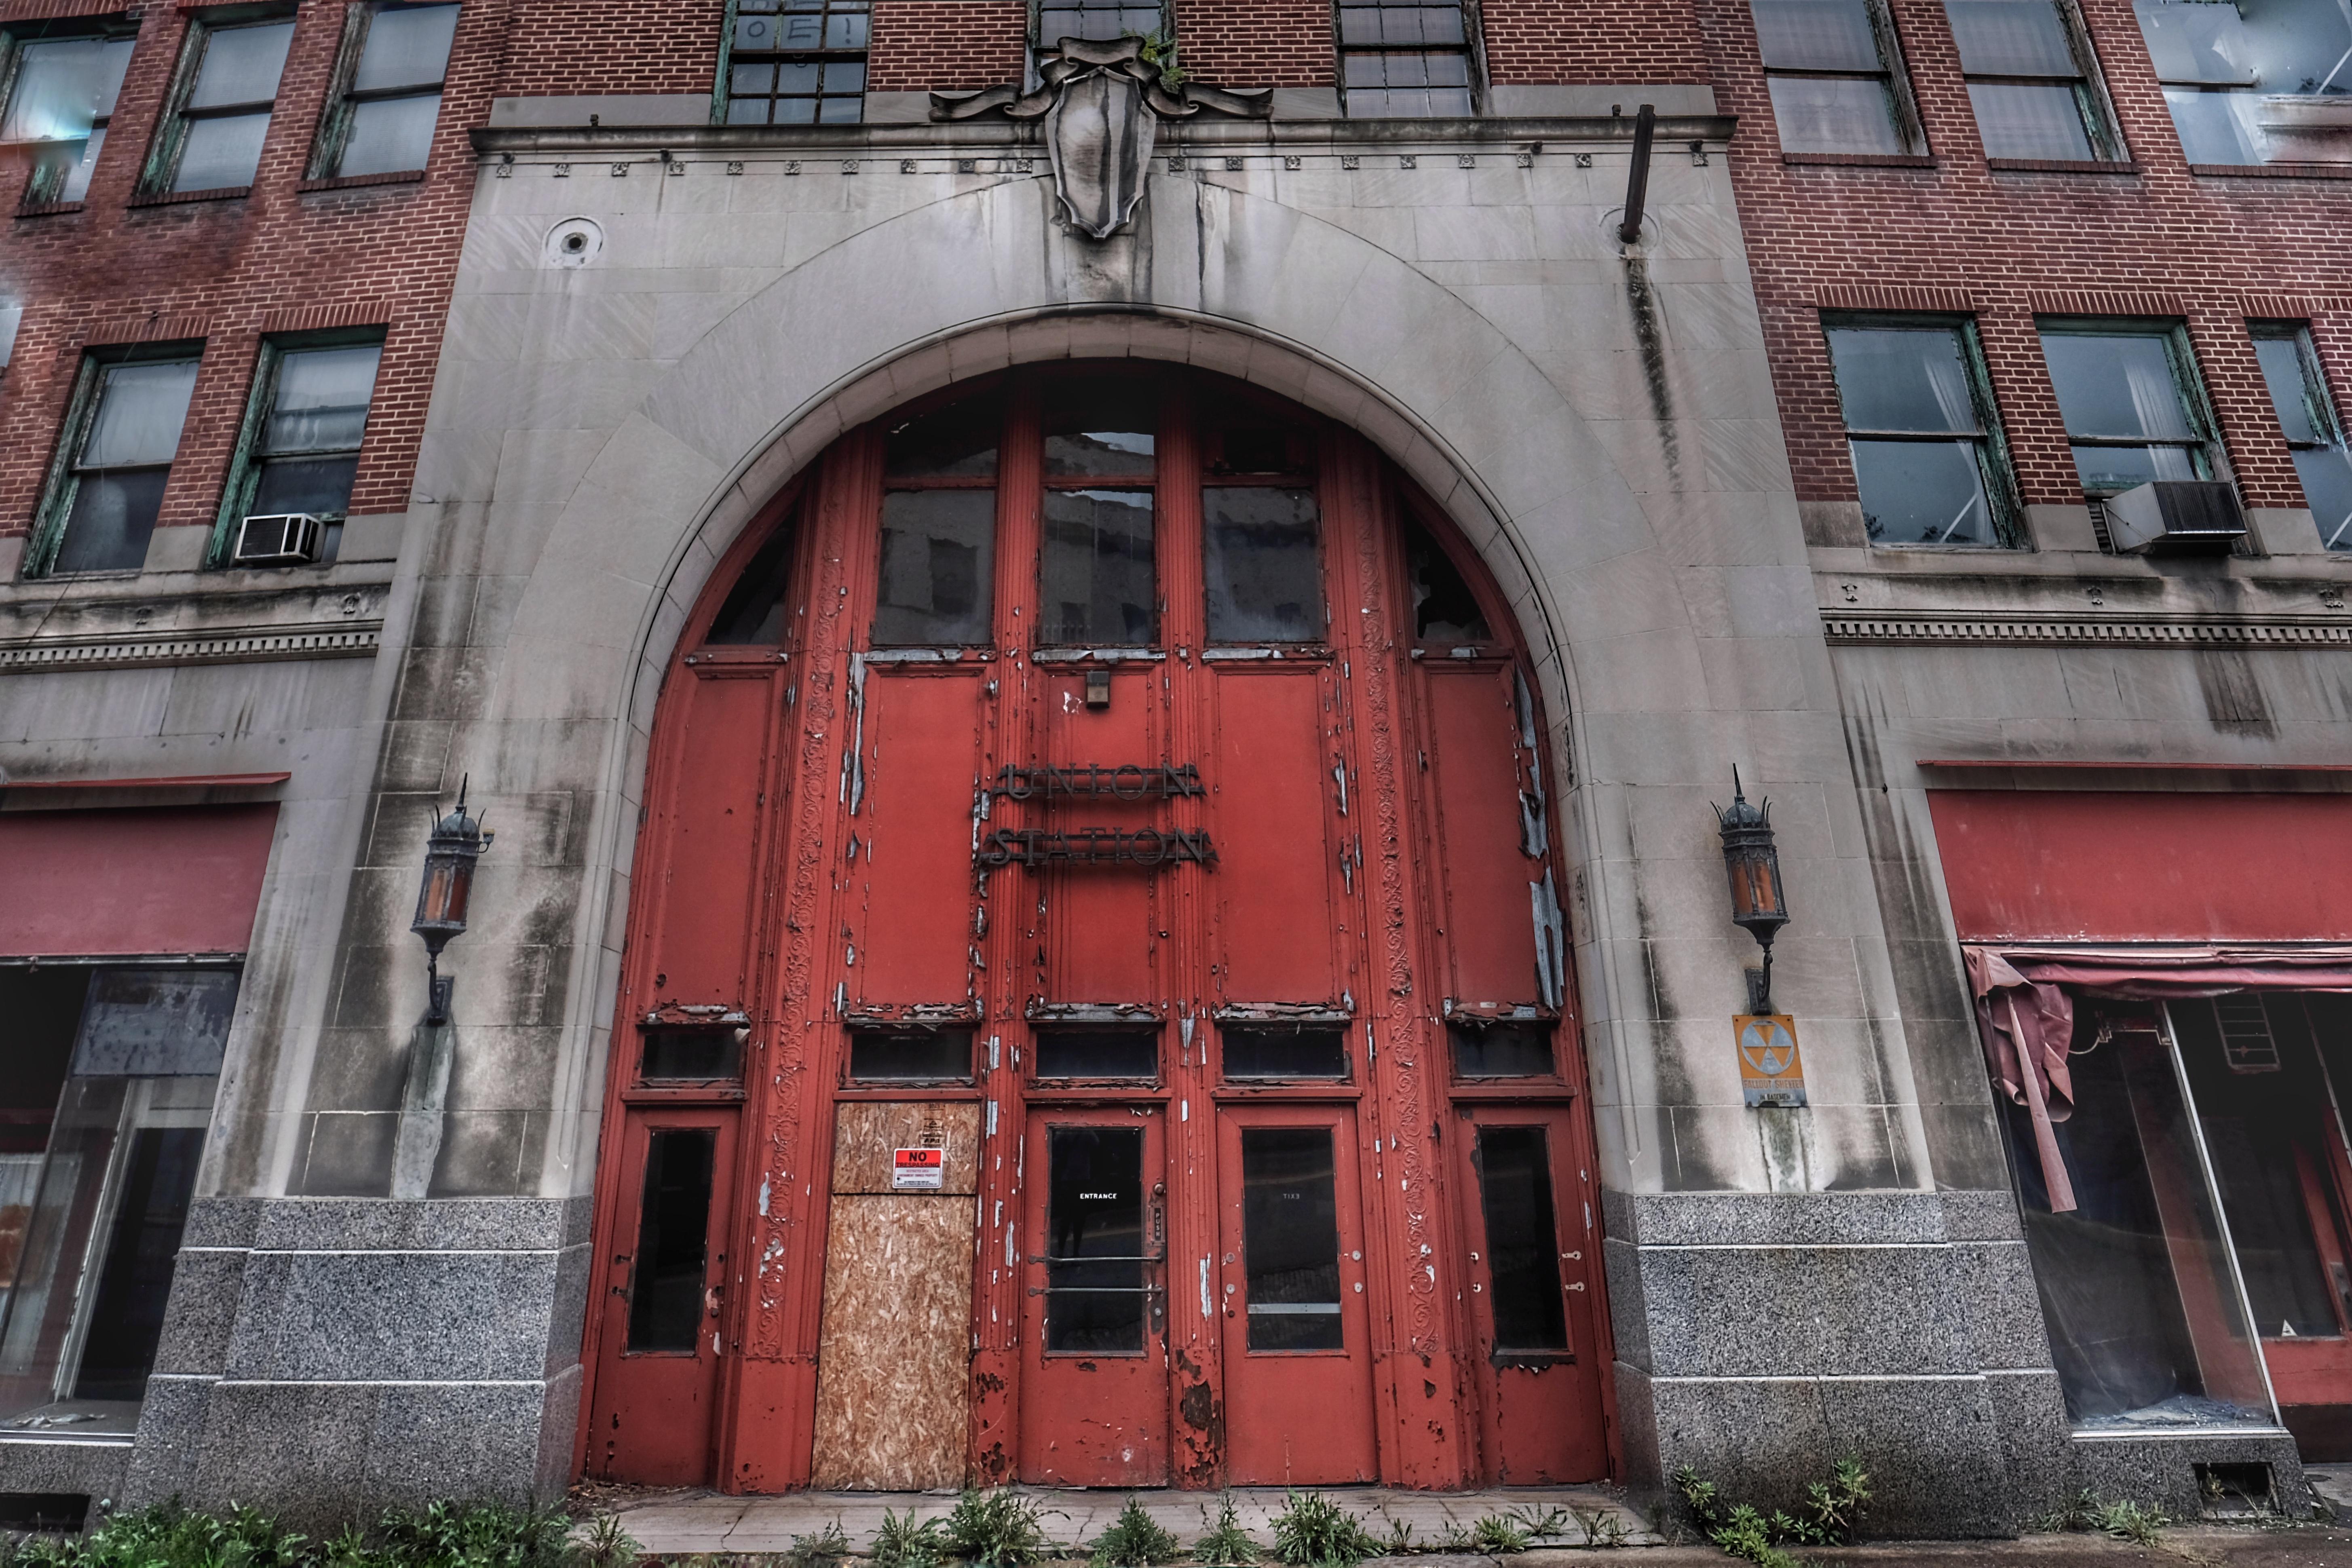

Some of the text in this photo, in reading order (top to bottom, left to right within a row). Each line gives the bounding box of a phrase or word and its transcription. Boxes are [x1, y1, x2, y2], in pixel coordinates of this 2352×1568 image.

[1006, 762, 1192, 800] UNION
[989, 827, 1205, 866] STATION
[1744, 1080, 1805, 1089] FALLOUT SHELTER
[908, 1152, 927, 1162] NO
